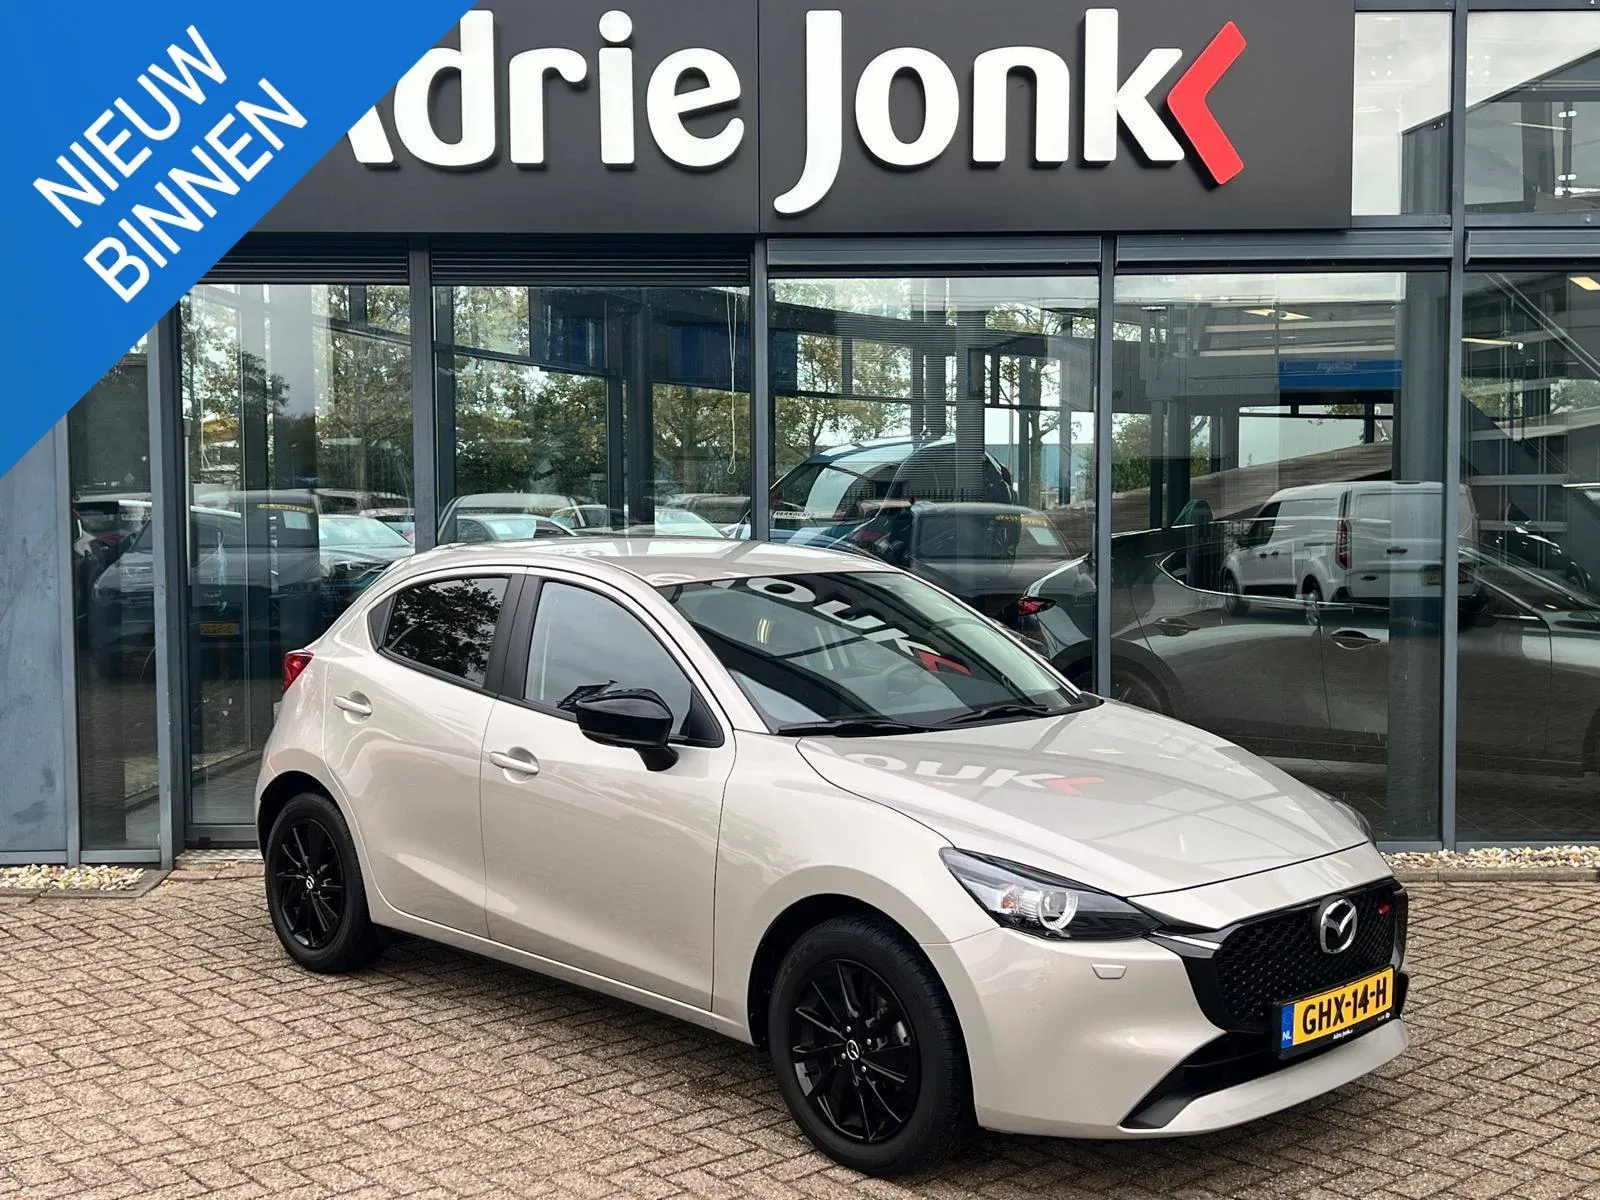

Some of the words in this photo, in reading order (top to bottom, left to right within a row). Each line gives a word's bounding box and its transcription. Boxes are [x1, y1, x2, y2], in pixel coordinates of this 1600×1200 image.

[347, 9, 745, 167] drie
[773, 8, 1185, 214] Jonk
[1302, 976, 1387, 1035] GHX-14-H
[1282, 1030, 1292, 1041] NL
